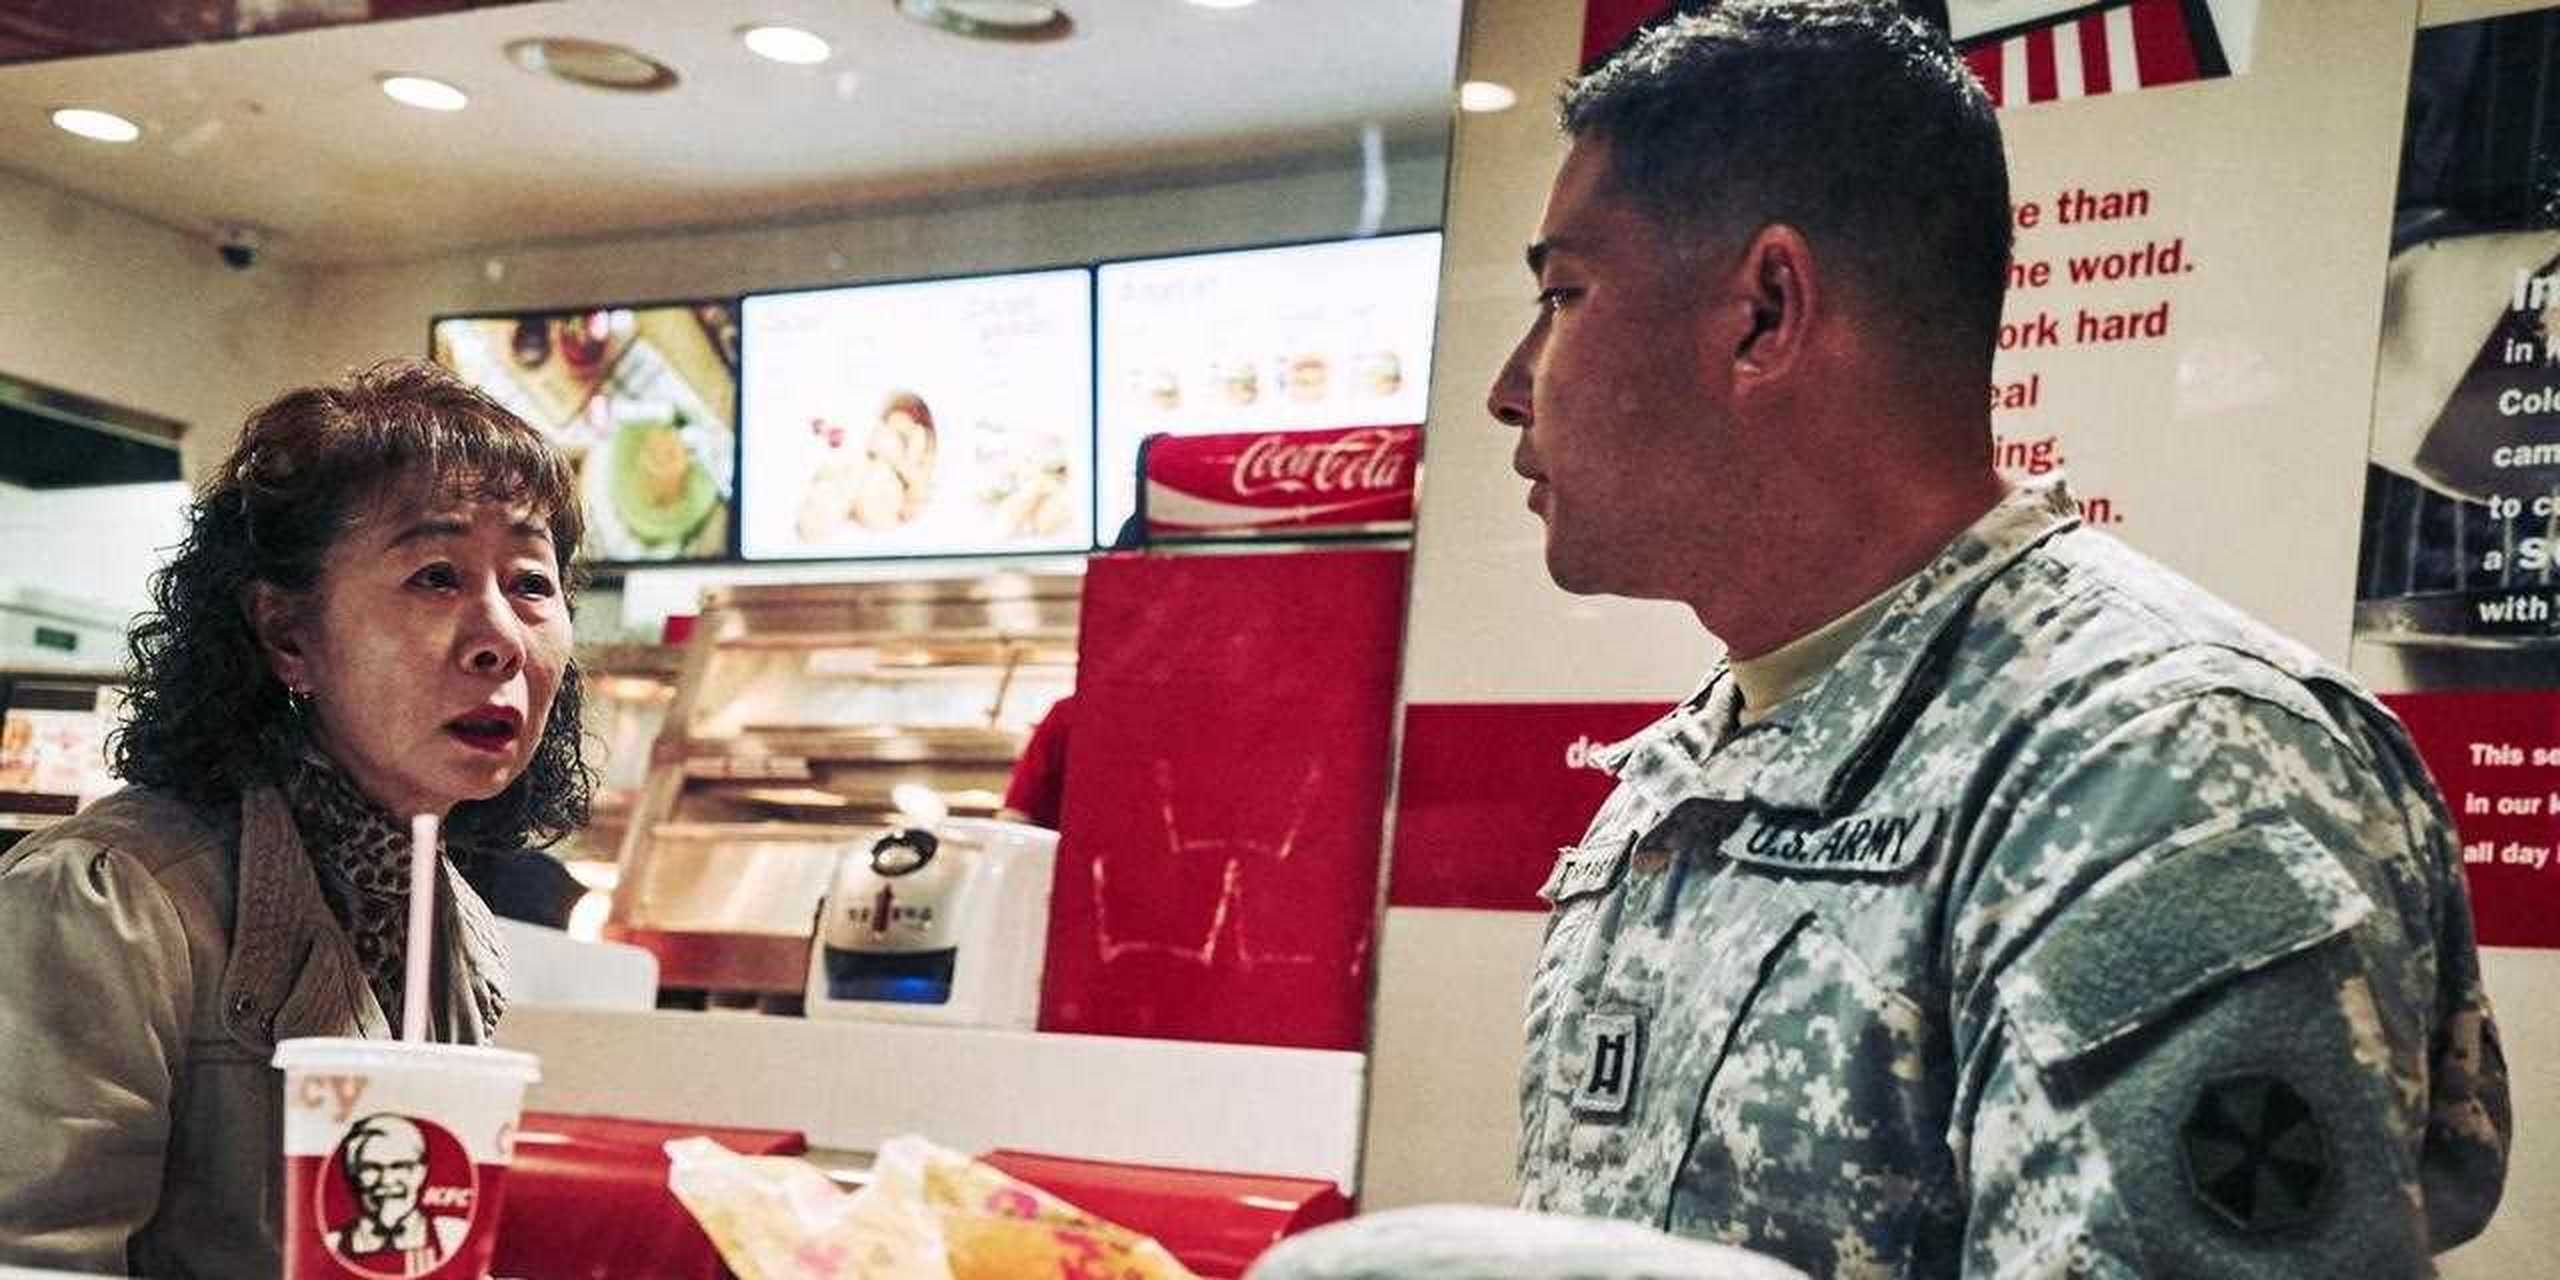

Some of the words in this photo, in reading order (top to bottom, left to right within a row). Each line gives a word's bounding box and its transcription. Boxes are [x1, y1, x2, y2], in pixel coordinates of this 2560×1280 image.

[2014, 202, 2041, 228] e
[2057, 188, 2149, 224] than
[2006, 261, 2050, 288] he
[2068, 238, 2193, 284] world.
[1997, 312, 2058, 350] ork
[2075, 301, 2168, 343] hard
[2504, 338, 2534, 364] in
[1985, 374, 2039, 408] eal
[1993, 434, 2064, 475] ing.
[2490, 494, 2522, 519] to
[2482, 550, 2503, 571] a
[2518, 537, 2560, 570] S
[2479, 595, 2549, 622] with
[2469, 743, 2525, 767] This
[2464, 792, 2491, 815] in
[2497, 796, 2543, 815] our
[1811, 812, 1920, 863] ARMY
[2463, 842, 2495, 865] all
[2501, 842, 2550, 870] day
[422, 1186, 474, 1208] KFC
